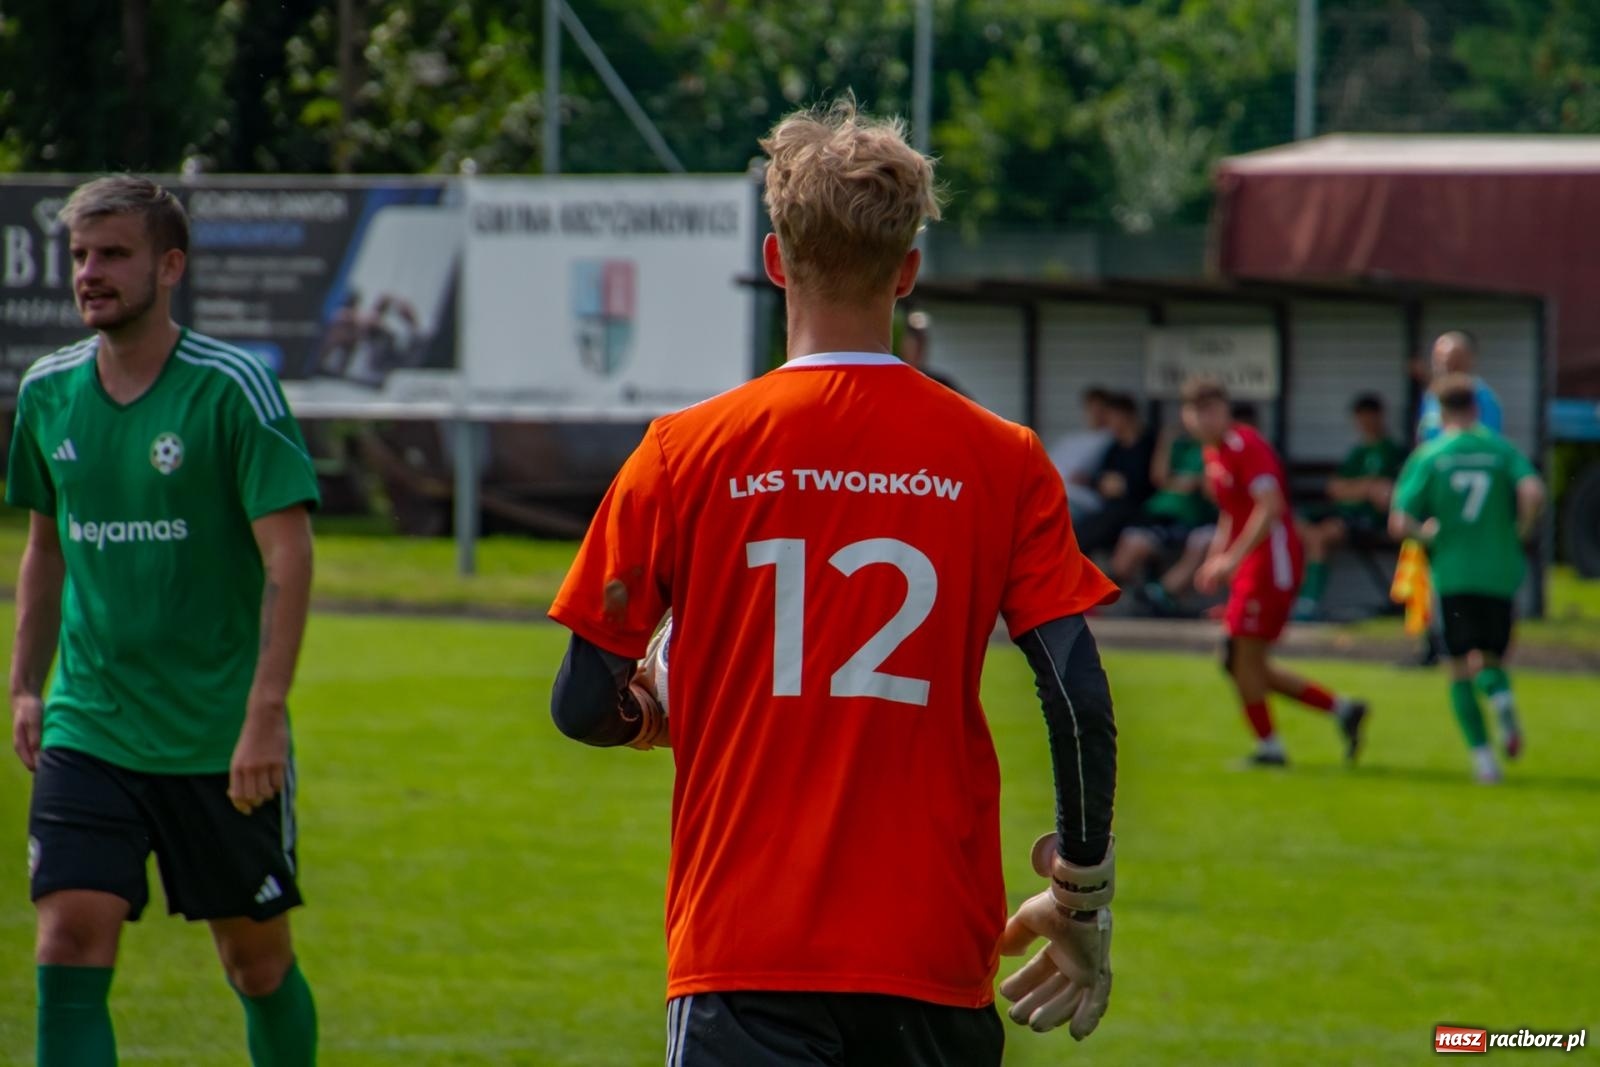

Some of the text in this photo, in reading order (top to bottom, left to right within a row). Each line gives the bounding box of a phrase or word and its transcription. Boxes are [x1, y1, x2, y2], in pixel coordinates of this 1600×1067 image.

[729, 469, 963, 500] LKS TWORKÓW
[1451, 470, 1489, 522] 7
[746, 538, 938, 706] 12
